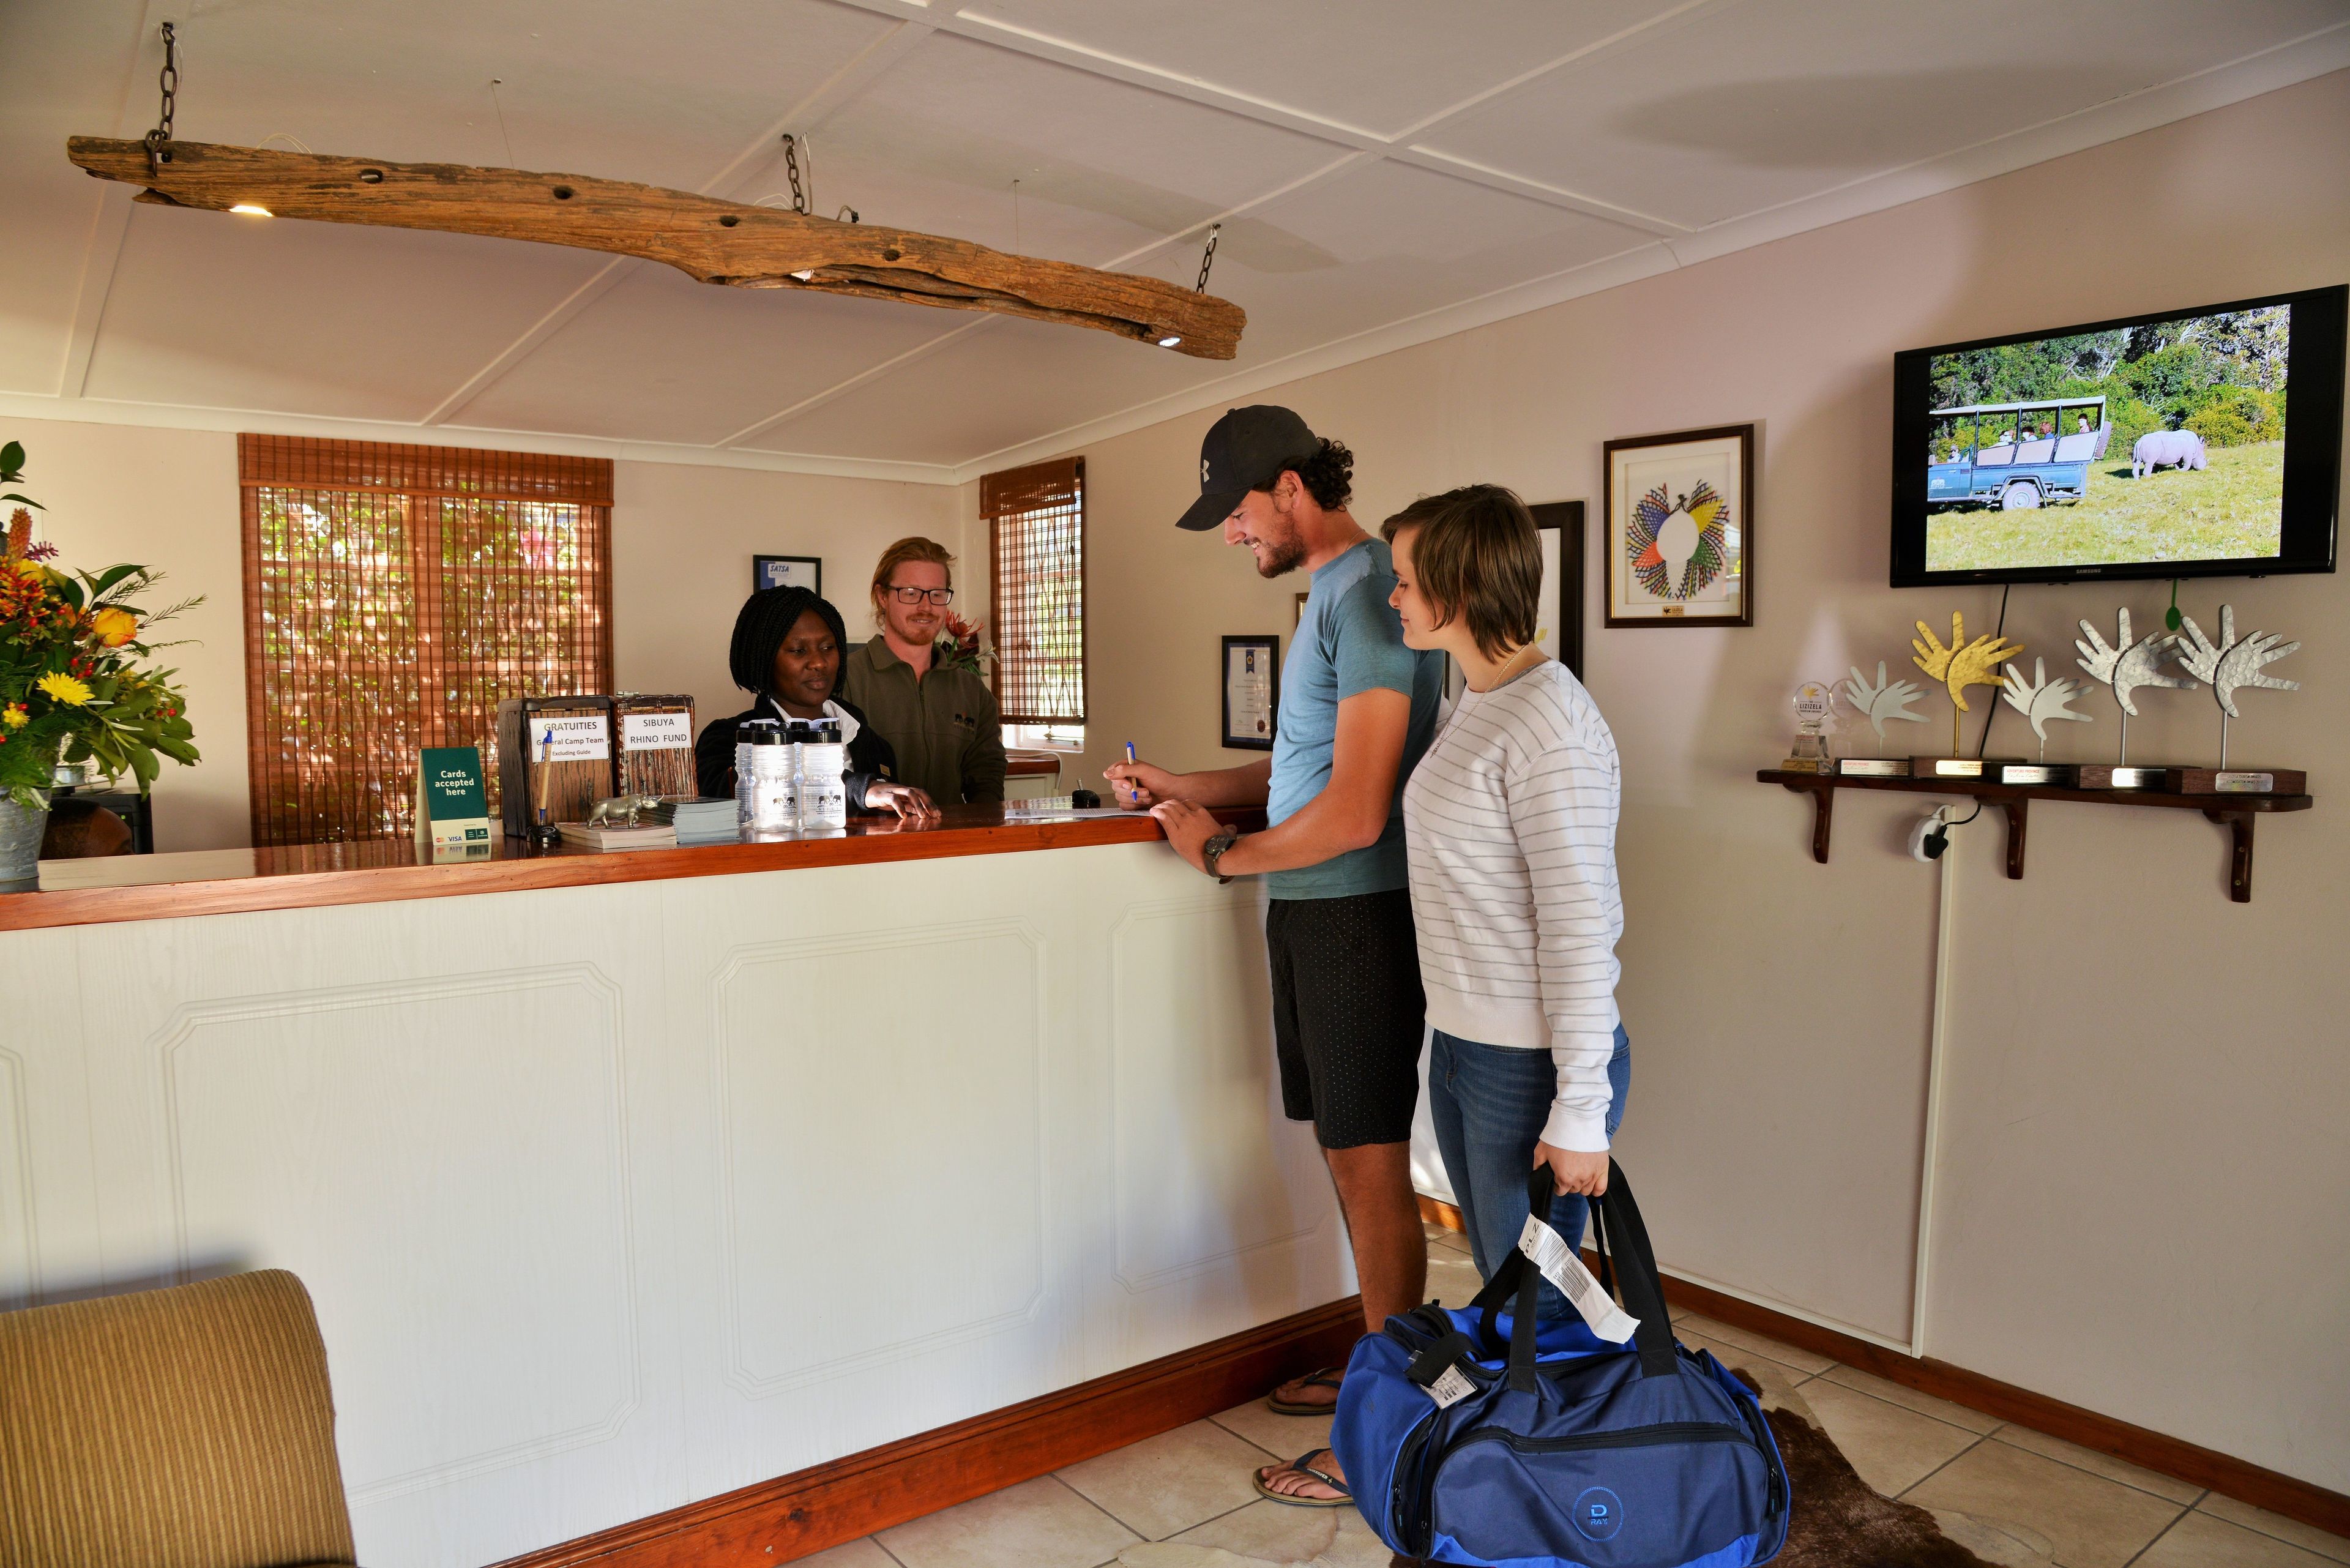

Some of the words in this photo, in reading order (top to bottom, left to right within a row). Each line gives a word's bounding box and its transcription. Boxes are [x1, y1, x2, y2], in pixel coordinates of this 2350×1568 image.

[544, 722, 597, 731] GRATUITIES
[643, 719, 674, 727] SIBUYA
[630, 735, 658, 744] RHINO
[663, 734, 687, 742] FUND
[441, 770, 466, 778] Cards
[435, 778, 474, 788] accepted
[1525, 1222, 1539, 1254] PLZ
[1591, 1504, 1608, 1517] D
